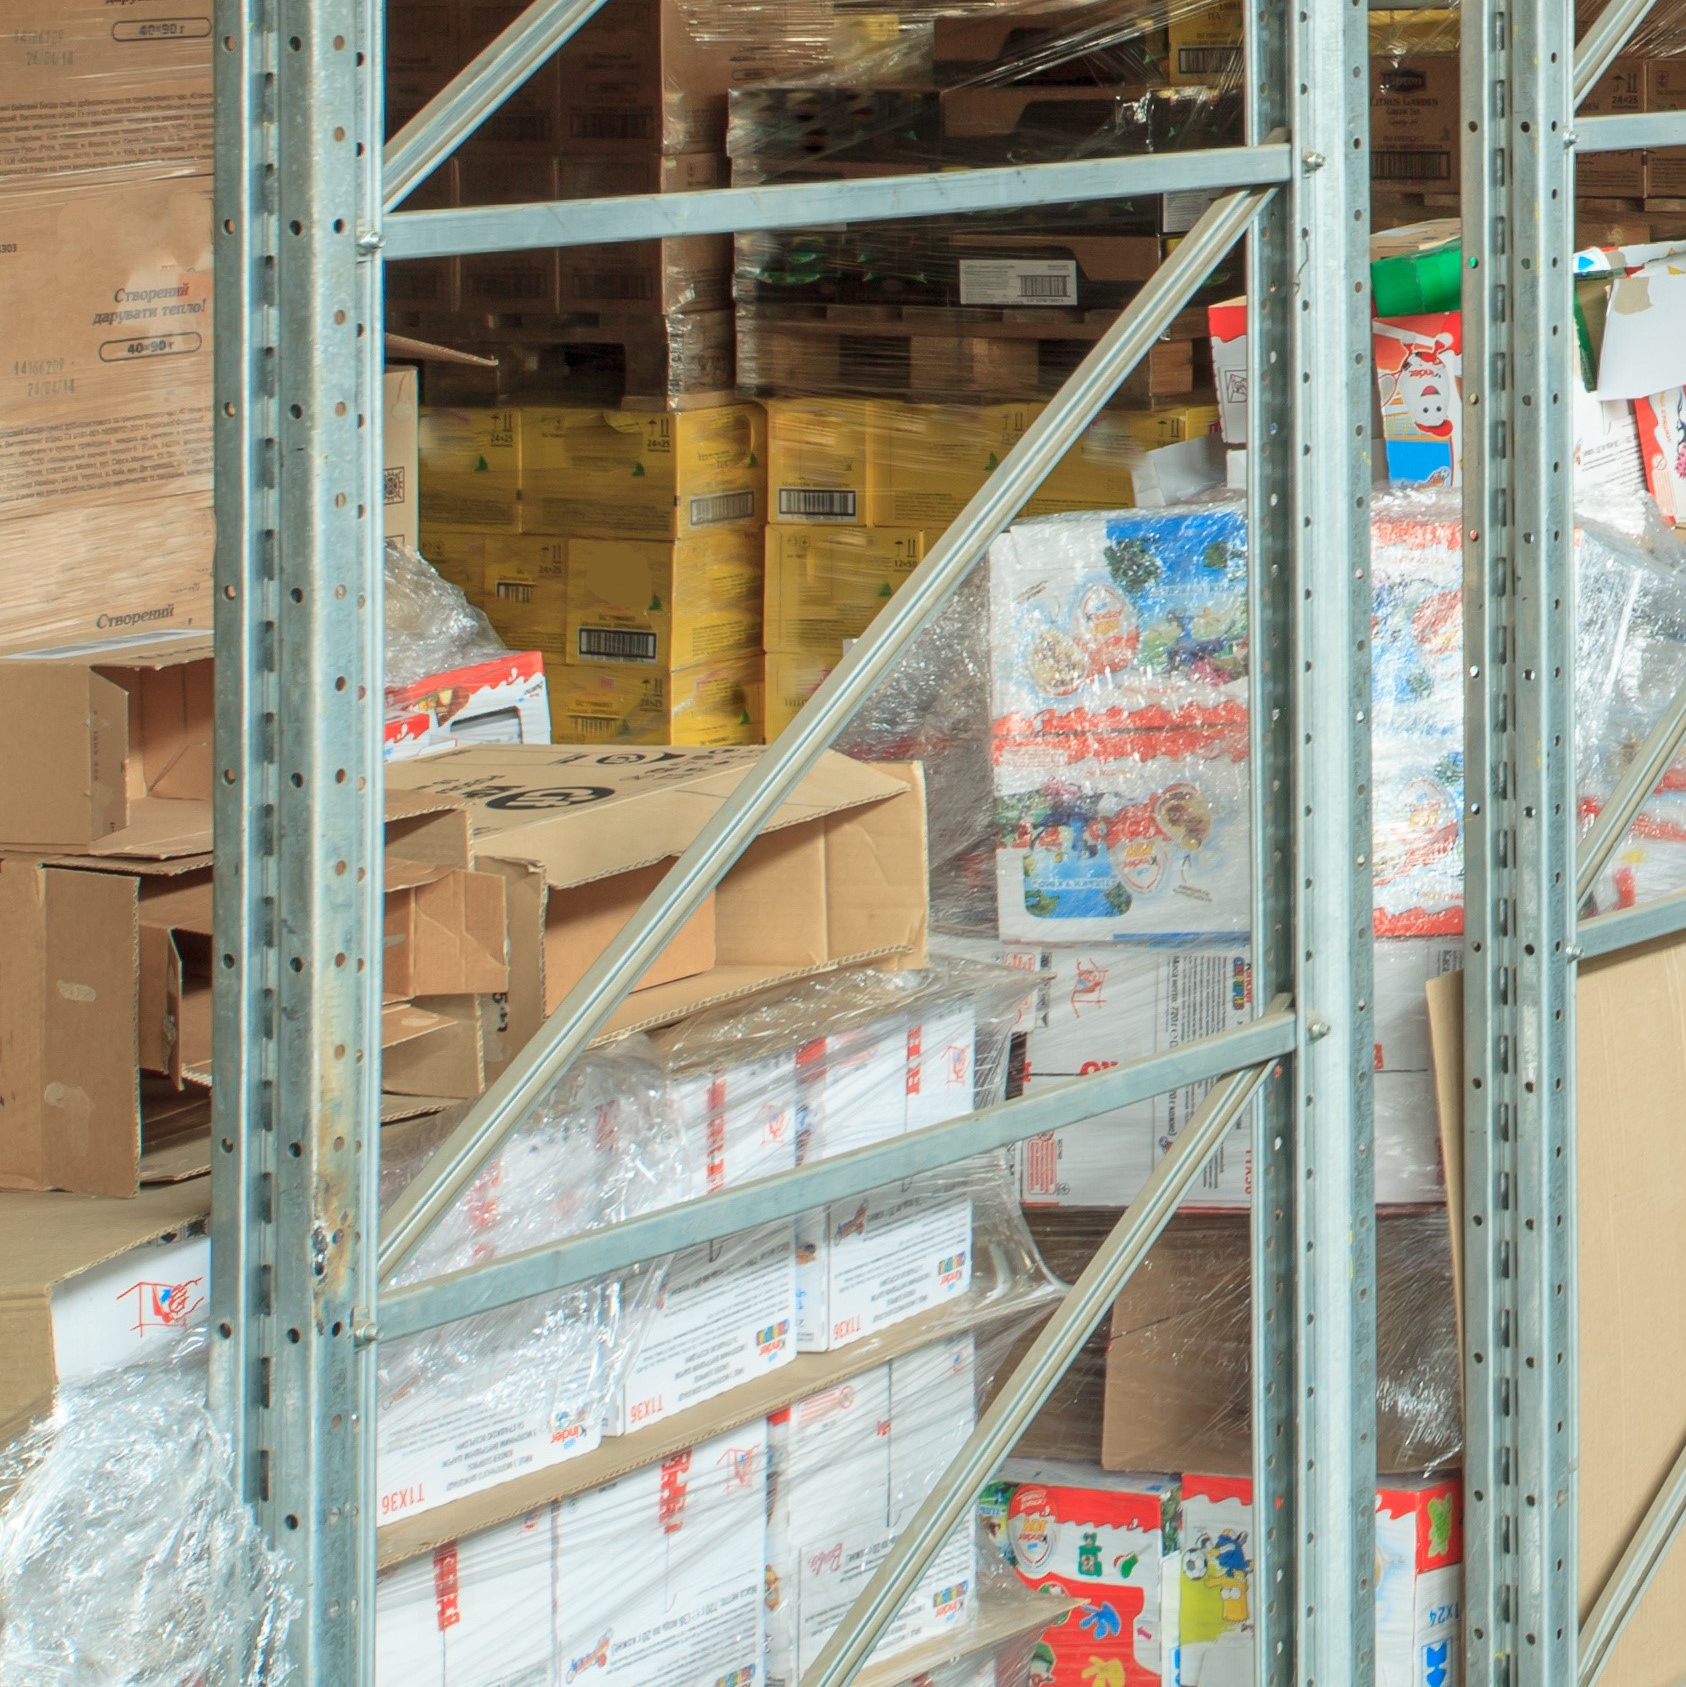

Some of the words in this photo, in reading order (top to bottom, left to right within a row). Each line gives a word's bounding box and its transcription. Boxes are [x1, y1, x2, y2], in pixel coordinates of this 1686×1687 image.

[114, 282, 190, 304] Створений
[92, 305, 158, 326] дарувати
[161, 296, 207, 318] тепло!
[96, 603, 175, 631] Створений
[551, 1424, 588, 1445] Kinder
